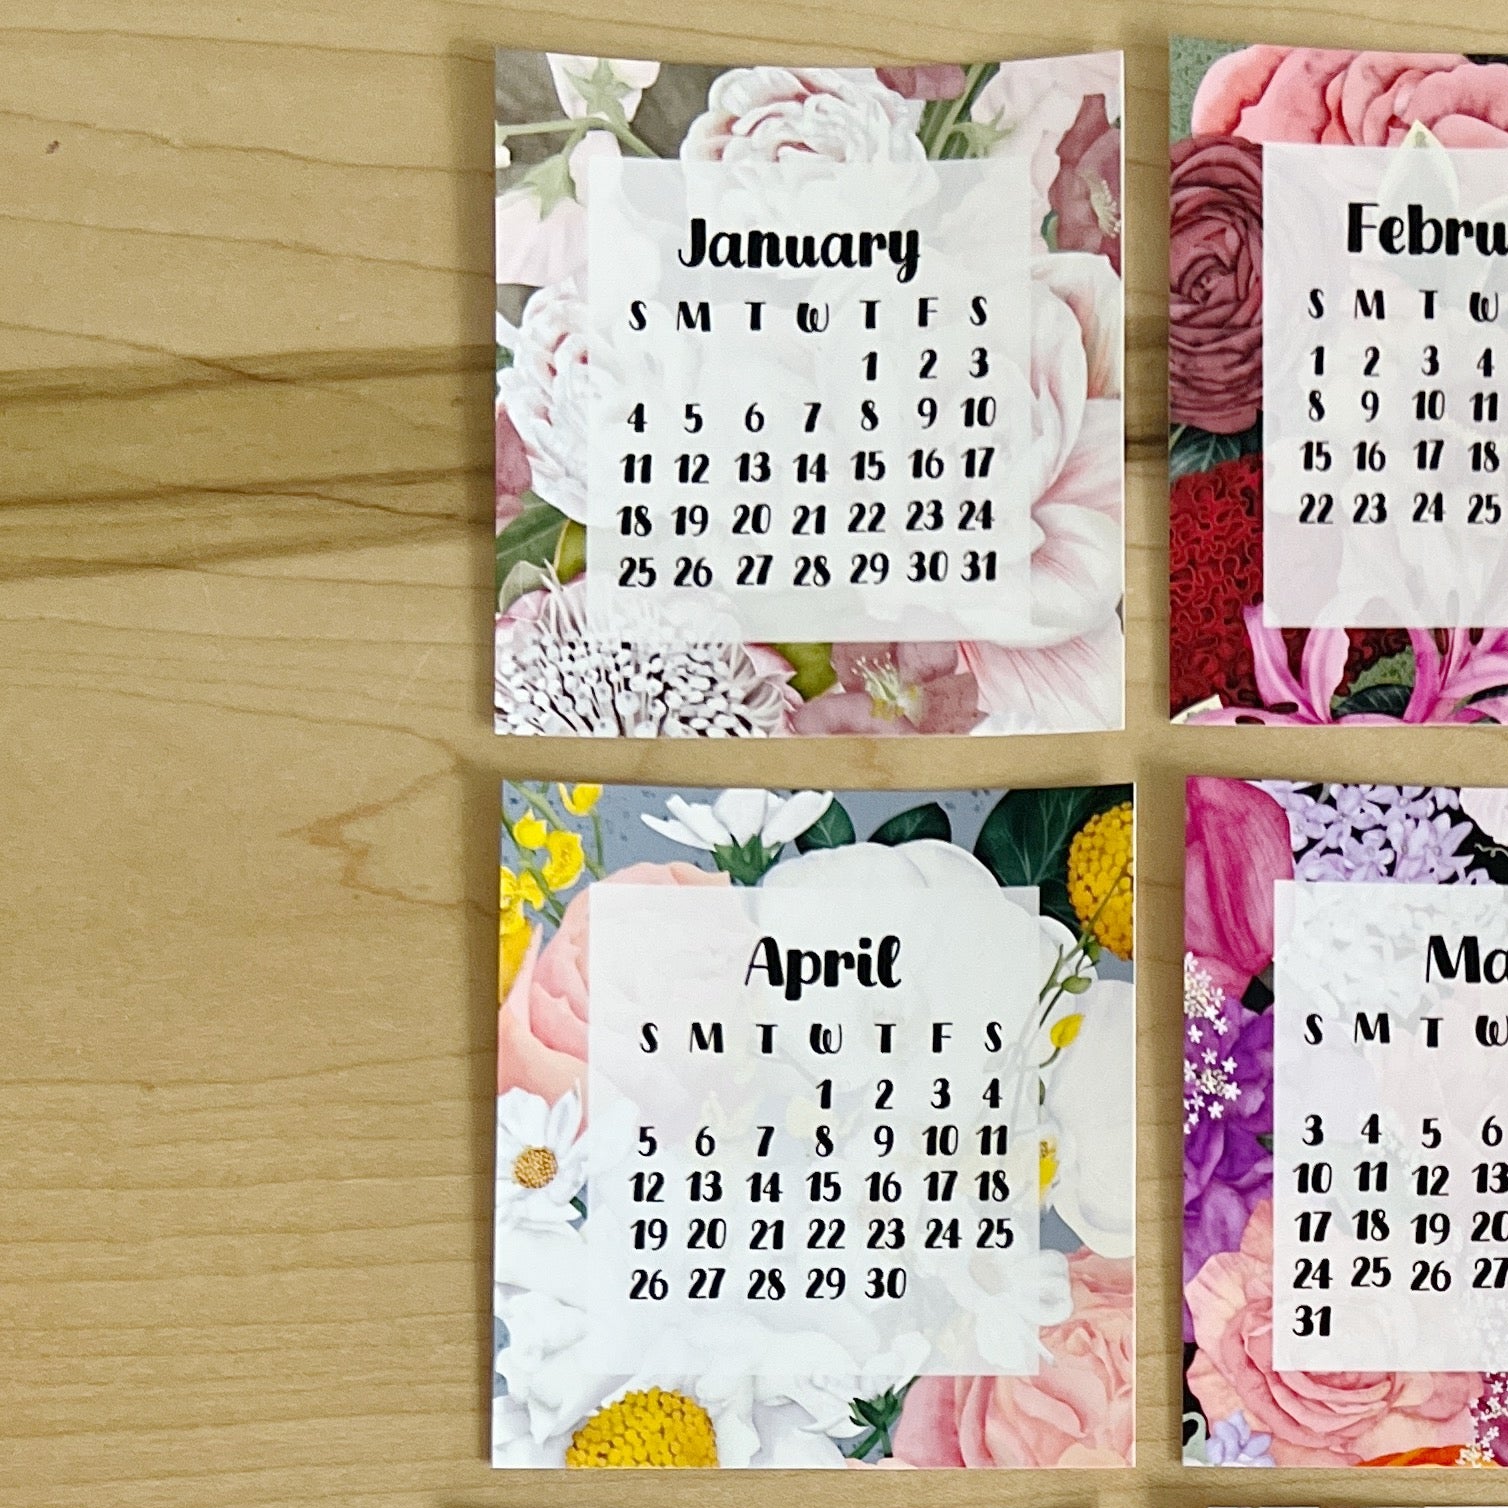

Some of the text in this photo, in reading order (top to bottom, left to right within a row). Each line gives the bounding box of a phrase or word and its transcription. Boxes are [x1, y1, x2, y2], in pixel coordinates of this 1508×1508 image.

[677, 217, 921, 284] January
[628, 295, 987, 334] S M T W T F S
[1308, 288, 1324, 320] S
[1354, 288, 1386, 320] M
[1419, 289, 1438, 320] T
[1469, 291, 1499, 323] W
[862, 347, 989, 381] 1 2 3
[1308, 389, 1326, 422] 8
[1360, 390, 1380, 423] 9
[1413, 389, 1446, 421] 10
[1471, 391, 1499, 423] 11
[744, 934, 902, 1002] April
[639, 1021, 1002, 1055] S M T W T F S
[1303, 1013, 1323, 1046] S
[1354, 1011, 1391, 1044] M
[1420, 1017, 1444, 1048] T
[629, 1267, 907, 1301] 26 27 28 29 30
[1292, 1304, 1332, 1337] 31
